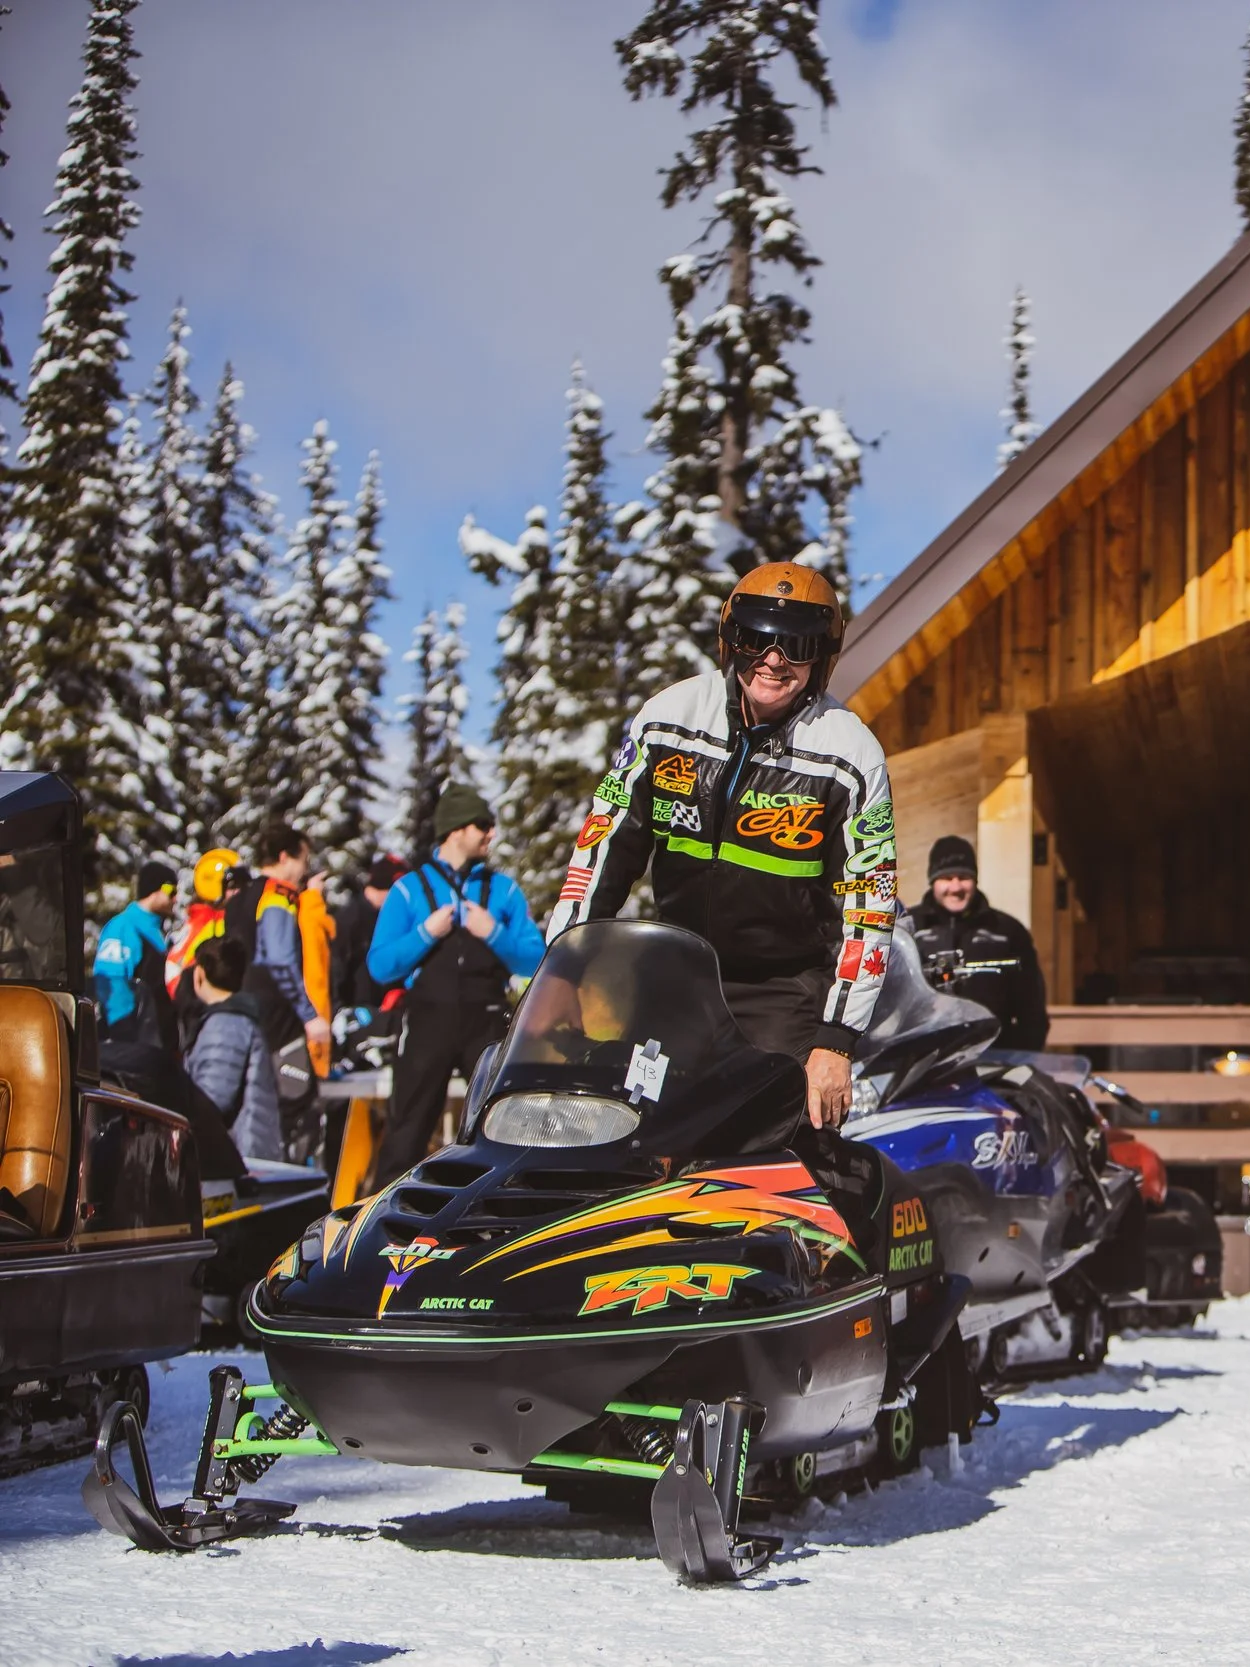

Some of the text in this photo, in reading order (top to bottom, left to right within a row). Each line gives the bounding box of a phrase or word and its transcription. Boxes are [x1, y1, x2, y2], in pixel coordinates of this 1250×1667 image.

[739, 789, 819, 809] ARCTIC
[833, 881, 876, 895] TEAM
[636, 1060, 657, 1080] 43
[893, 1197, 927, 1238] 600
[889, 1239, 934, 1271] ARCTIC CAT
[577, 1263, 762, 1317] ZRT
[420, 1297, 494, 1310] ARCTIC CAT
